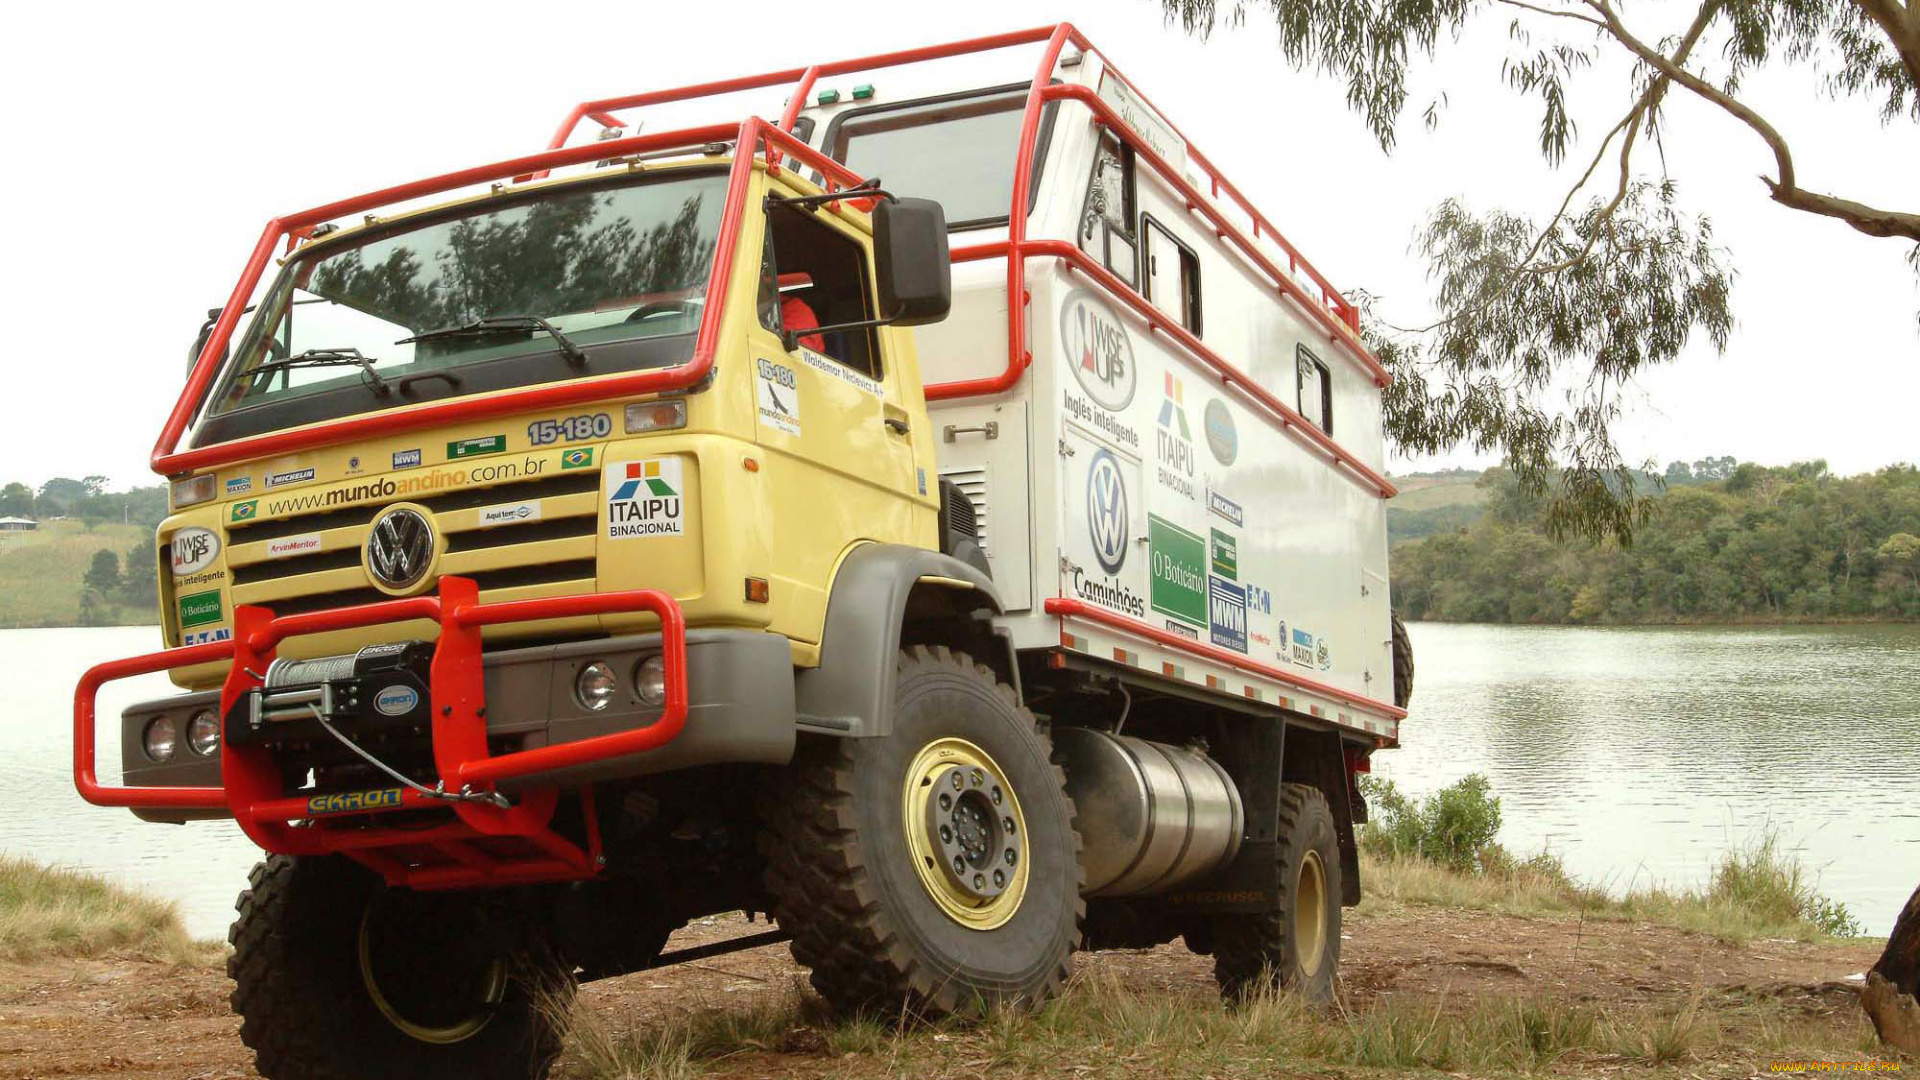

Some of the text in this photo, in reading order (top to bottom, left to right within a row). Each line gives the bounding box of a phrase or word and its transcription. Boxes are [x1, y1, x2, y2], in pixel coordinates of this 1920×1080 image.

[1094, 315, 1124, 360] WISE
[757, 358, 797, 390] 15-180
[803, 350, 841, 377] Waldemar
[1095, 347, 1125, 389] UP
[528, 413, 612, 446] 15-180
[1094, 405, 1139, 448] inteligente
[394, 454, 420, 465] MWM
[1157, 427, 1194, 478] ITAIPU
[227, 483, 251, 493] MAXION
[269, 457, 547, 515] www.mundoandino.com.br
[274, 470, 314, 484] MICHELIN
[609, 498, 680, 523] ITAIPU
[183, 533, 209, 551] WISE
[610, 522, 680, 537] BINACIONAL
[183, 547, 209, 565] UP
[271, 540, 317, 552] ArvinMeritor
[184, 570, 225, 586] inteligente
[1153, 550, 1204, 594] O Boticário
[1074, 566, 1144, 617] Caminhões
[188, 601, 219, 616] Boticário
[1212, 597, 1245, 633] MWM
[309, 788, 402, 811] EKRON
